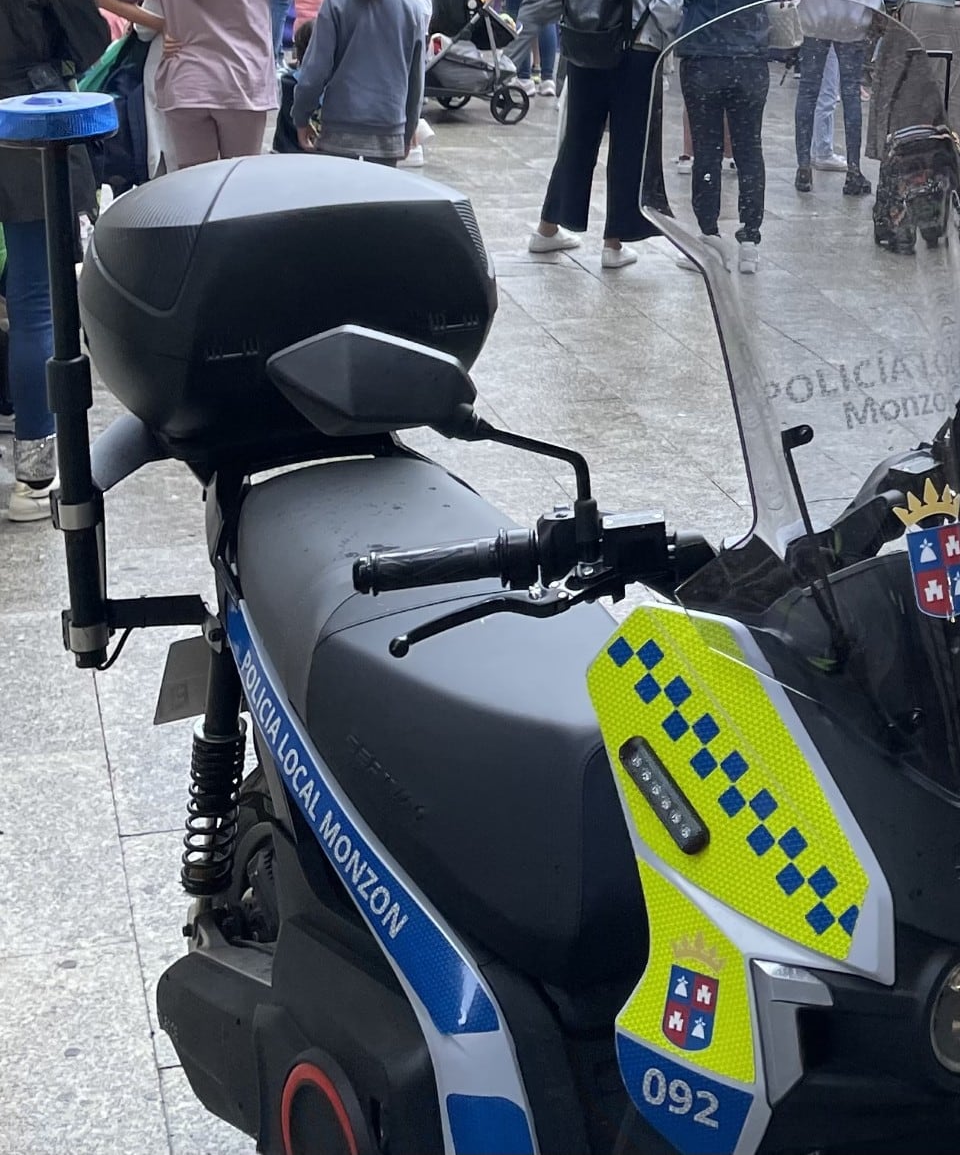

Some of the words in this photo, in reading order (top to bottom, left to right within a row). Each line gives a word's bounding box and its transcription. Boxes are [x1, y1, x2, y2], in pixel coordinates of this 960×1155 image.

[240, 649, 282, 745] POLICIA
[276, 732, 324, 823] LOCAL
[318, 809, 409, 940] MONZON
[642, 1067, 719, 1130] 092
